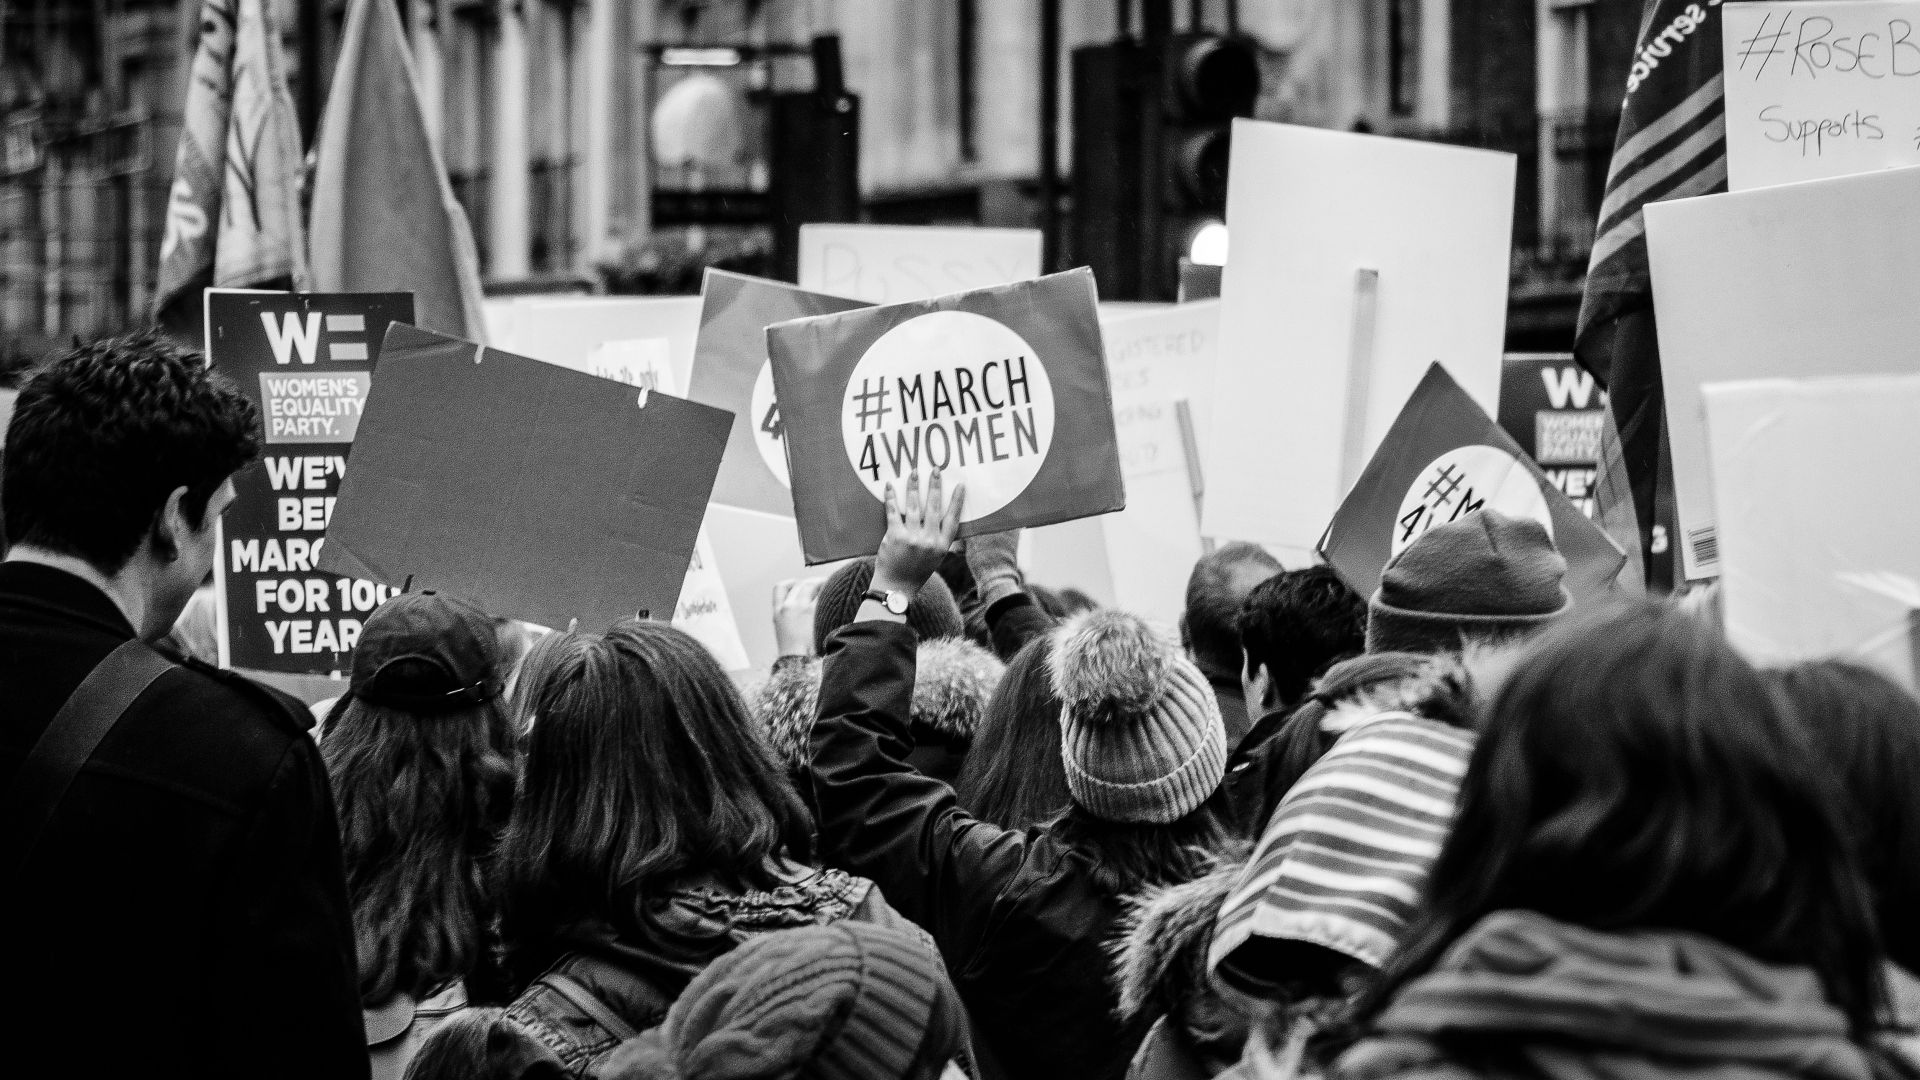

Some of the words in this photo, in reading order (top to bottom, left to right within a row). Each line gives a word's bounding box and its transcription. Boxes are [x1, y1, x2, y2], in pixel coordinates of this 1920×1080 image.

[1758, 104, 1884, 157] Supports
[267, 378, 359, 397] WOMEN'S
[852, 356, 1031, 433] #MARCH
[859, 407, 1039, 482] 4WOMEN
[256, 579, 330, 614] FOR
